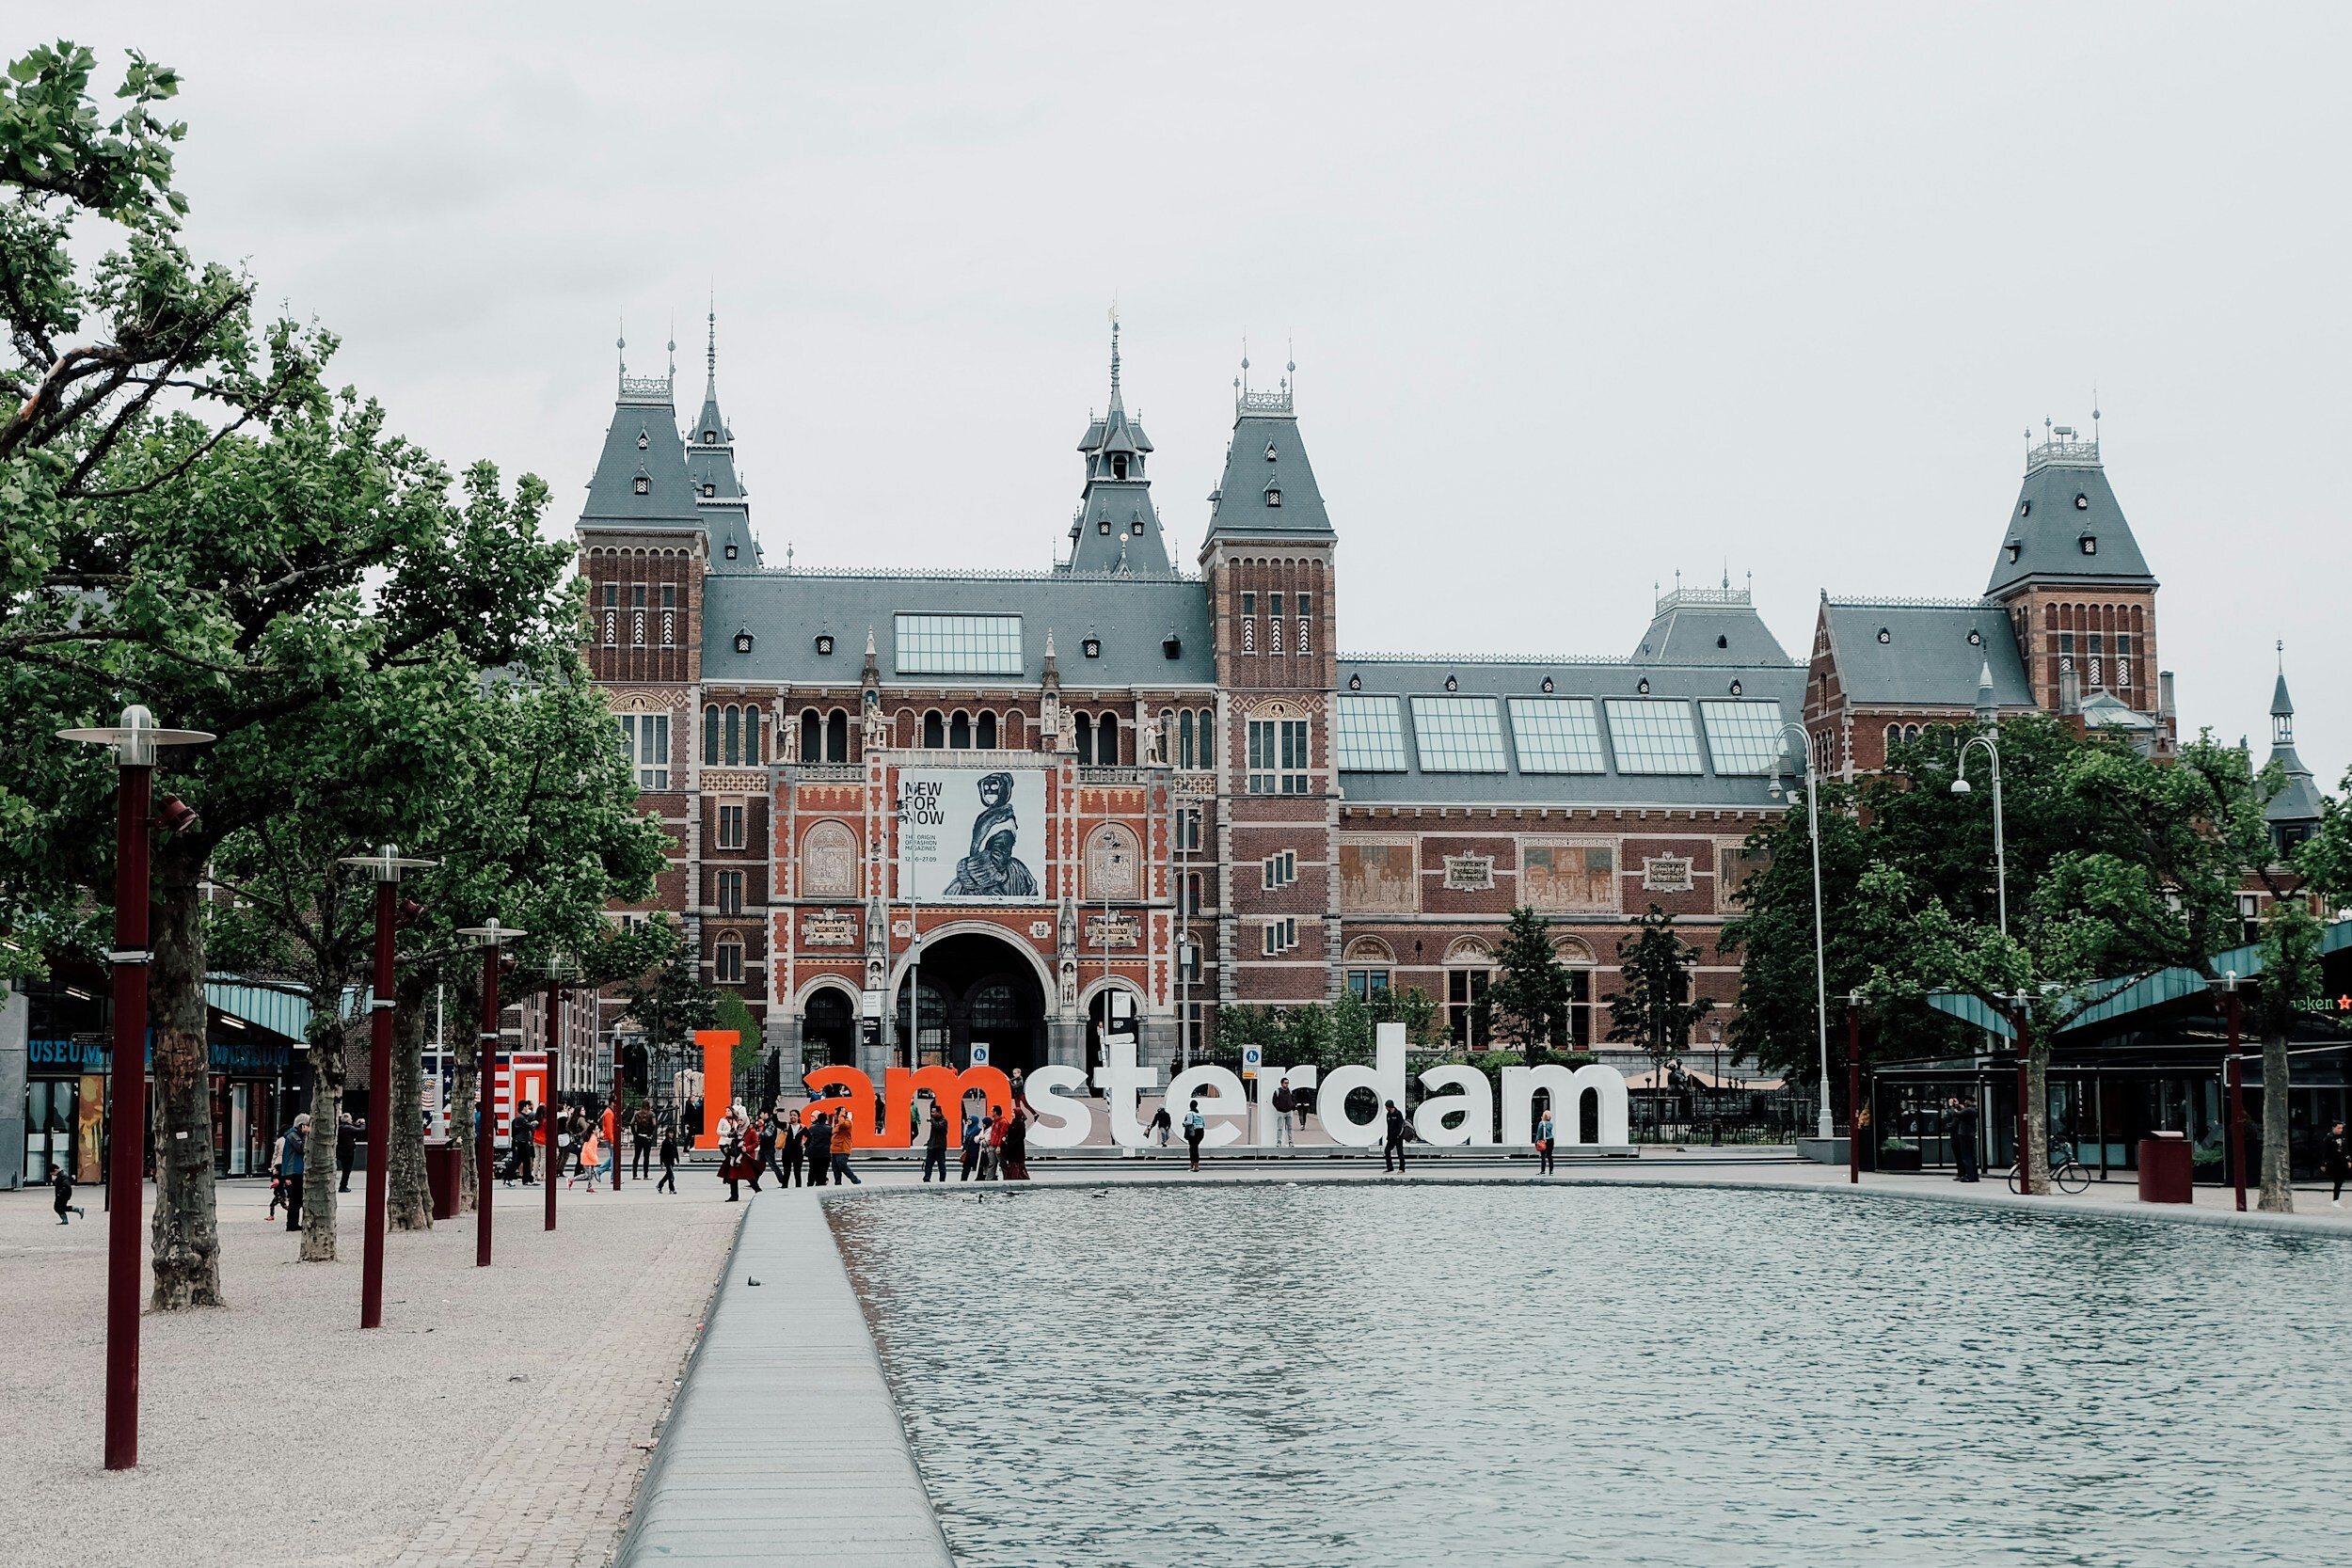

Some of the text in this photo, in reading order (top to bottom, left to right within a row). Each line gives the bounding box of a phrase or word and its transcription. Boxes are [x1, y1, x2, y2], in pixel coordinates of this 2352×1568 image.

[905, 782, 943, 796] NEW
[905, 797, 936, 810] FOR
[905, 811, 945, 825] NOW
[28, 1039, 102, 1064] USEUM
[210, 1043, 292, 1066] MUSEUM
[694, 1030, 740, 1148] I
